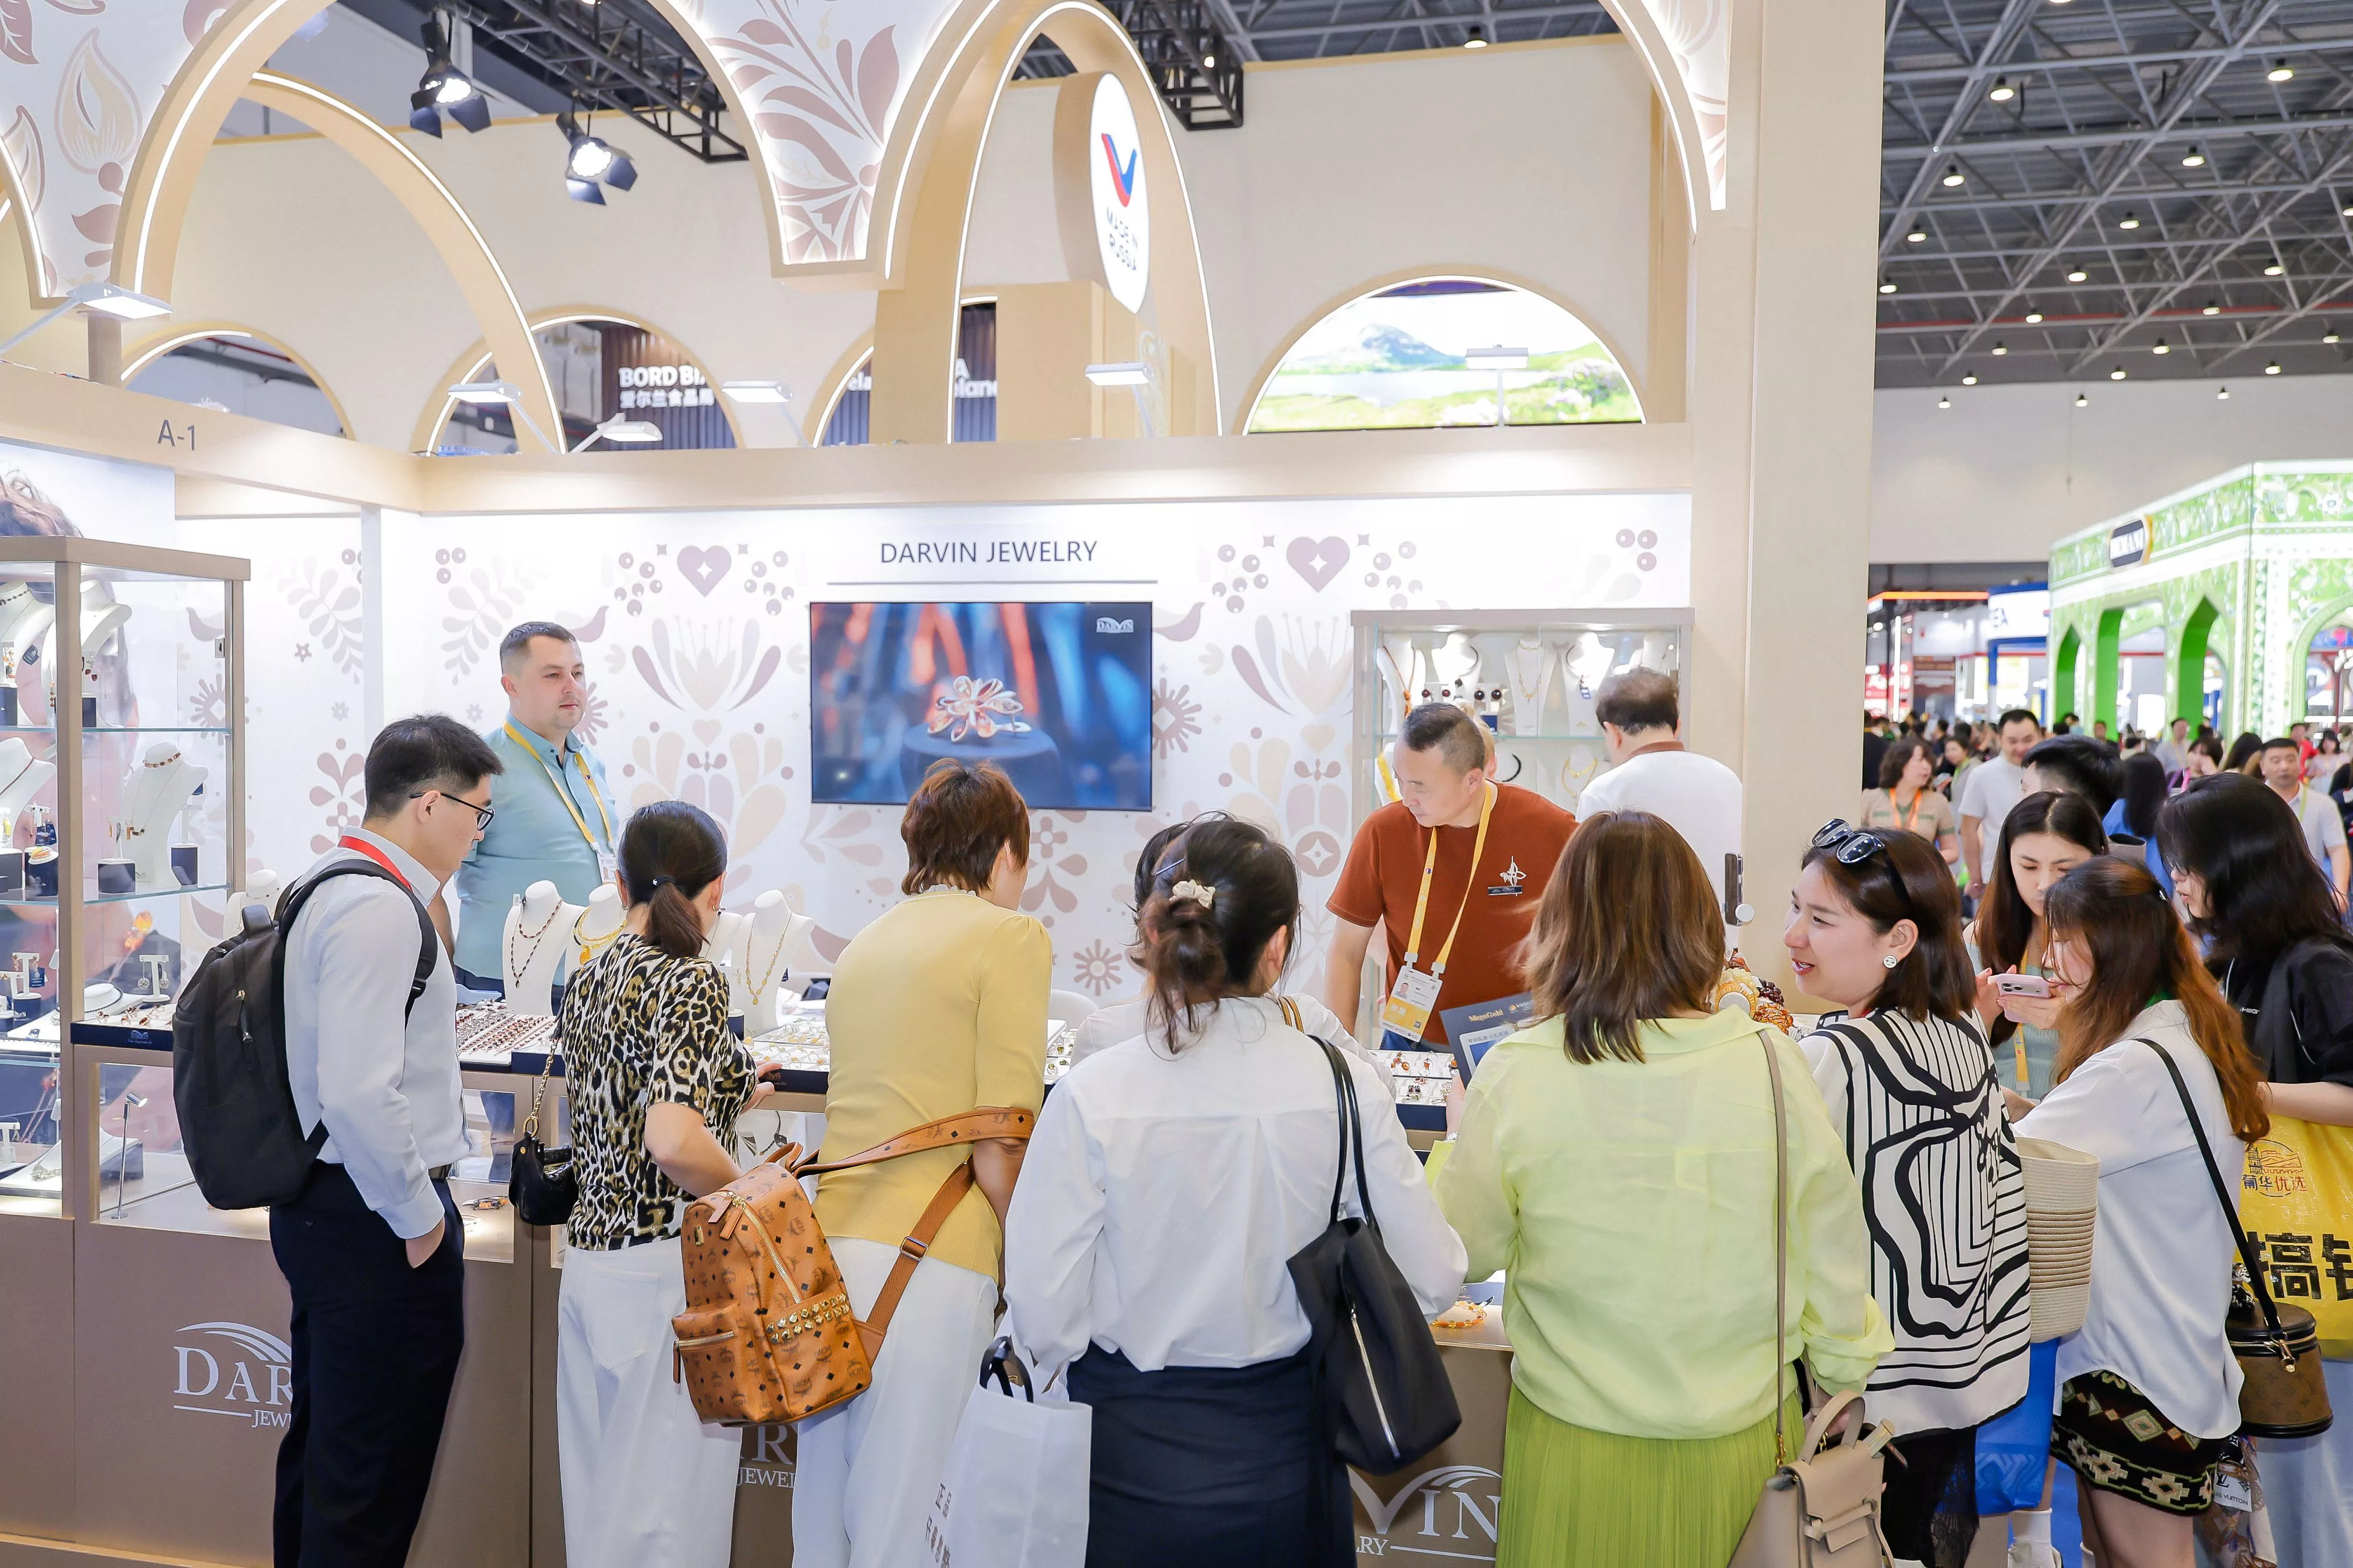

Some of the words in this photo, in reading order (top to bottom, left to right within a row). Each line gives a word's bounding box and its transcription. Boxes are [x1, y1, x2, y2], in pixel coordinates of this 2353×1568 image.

[618, 365, 678, 388] BORD
[158, 419, 195, 451] A-1
[881, 542, 977, 563] DARVIN
[986, 541, 1097, 562] JEWELRY
[252, 1409, 291, 1427] JEW
[2224, 1494, 2248, 1506] VUITTON
